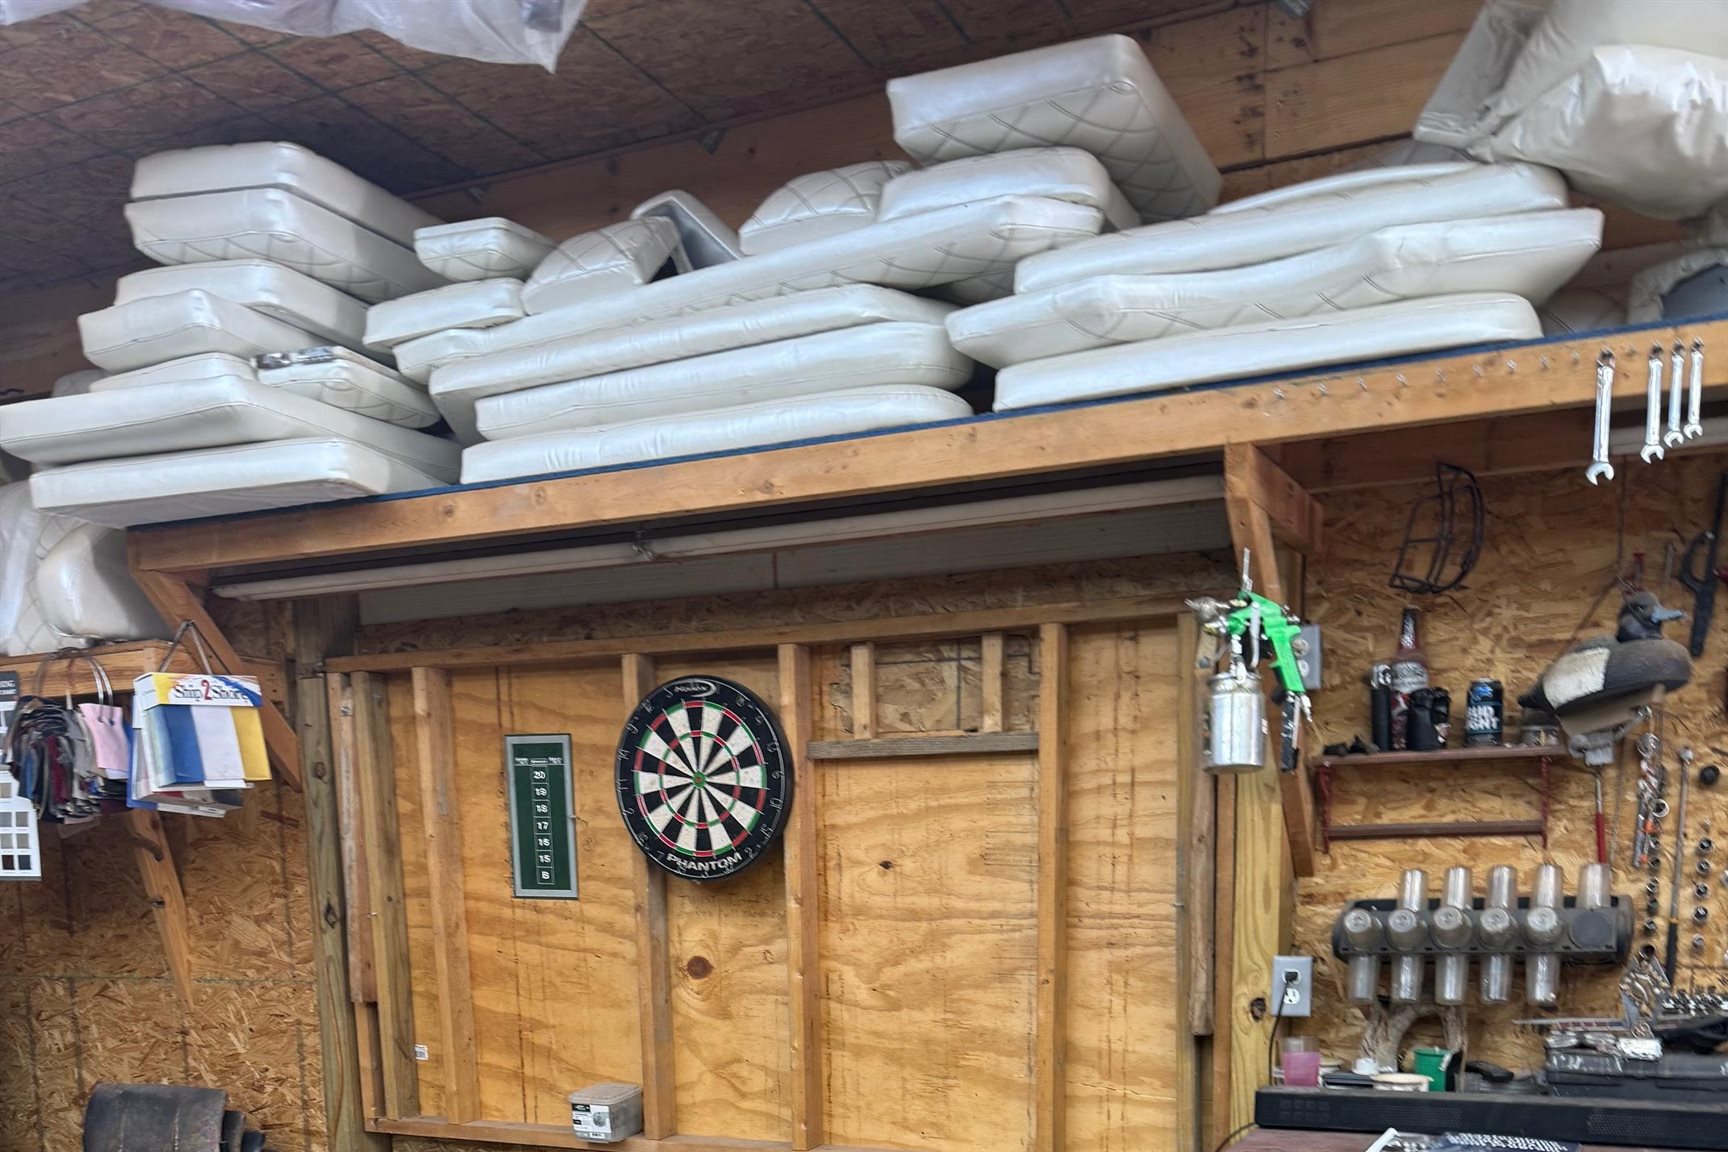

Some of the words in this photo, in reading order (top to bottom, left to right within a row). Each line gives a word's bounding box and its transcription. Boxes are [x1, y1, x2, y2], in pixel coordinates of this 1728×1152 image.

[201, 679, 213, 700] 2
[533, 770, 546, 780] 20
[535, 787, 548, 797] 19
[536, 804, 549, 813] 18
[537, 821, 549, 830] 17
[538, 838, 551, 847] 16
[539, 855, 551, 863] 15
[666, 851, 743, 872] PHANTOM
